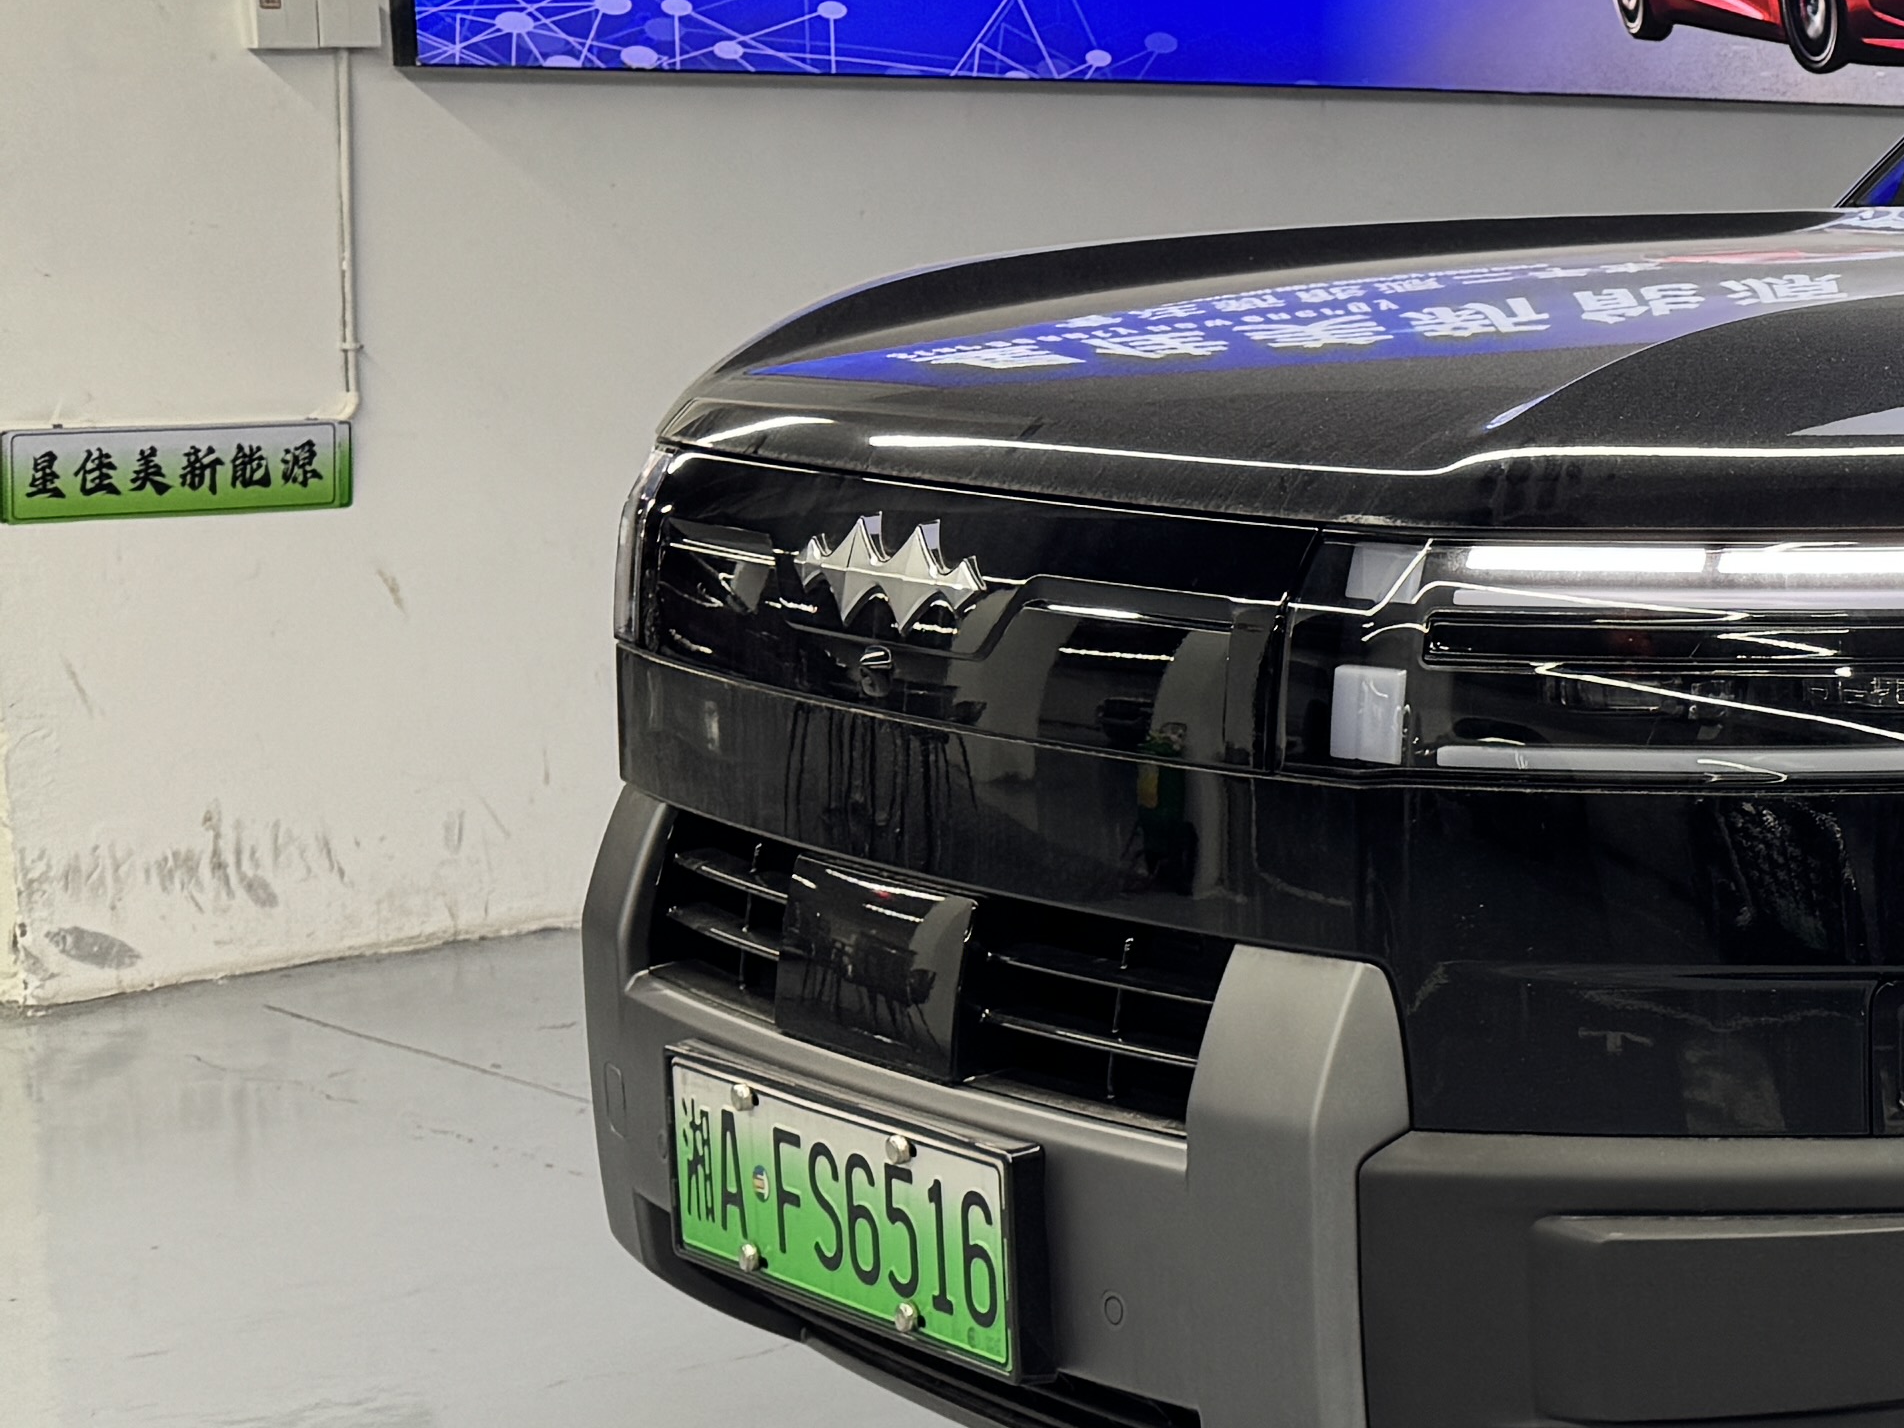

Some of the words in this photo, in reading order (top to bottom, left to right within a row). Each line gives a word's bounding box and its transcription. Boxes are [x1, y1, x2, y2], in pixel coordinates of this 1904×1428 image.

[24, 438, 325, 500] 星佳美新能源
